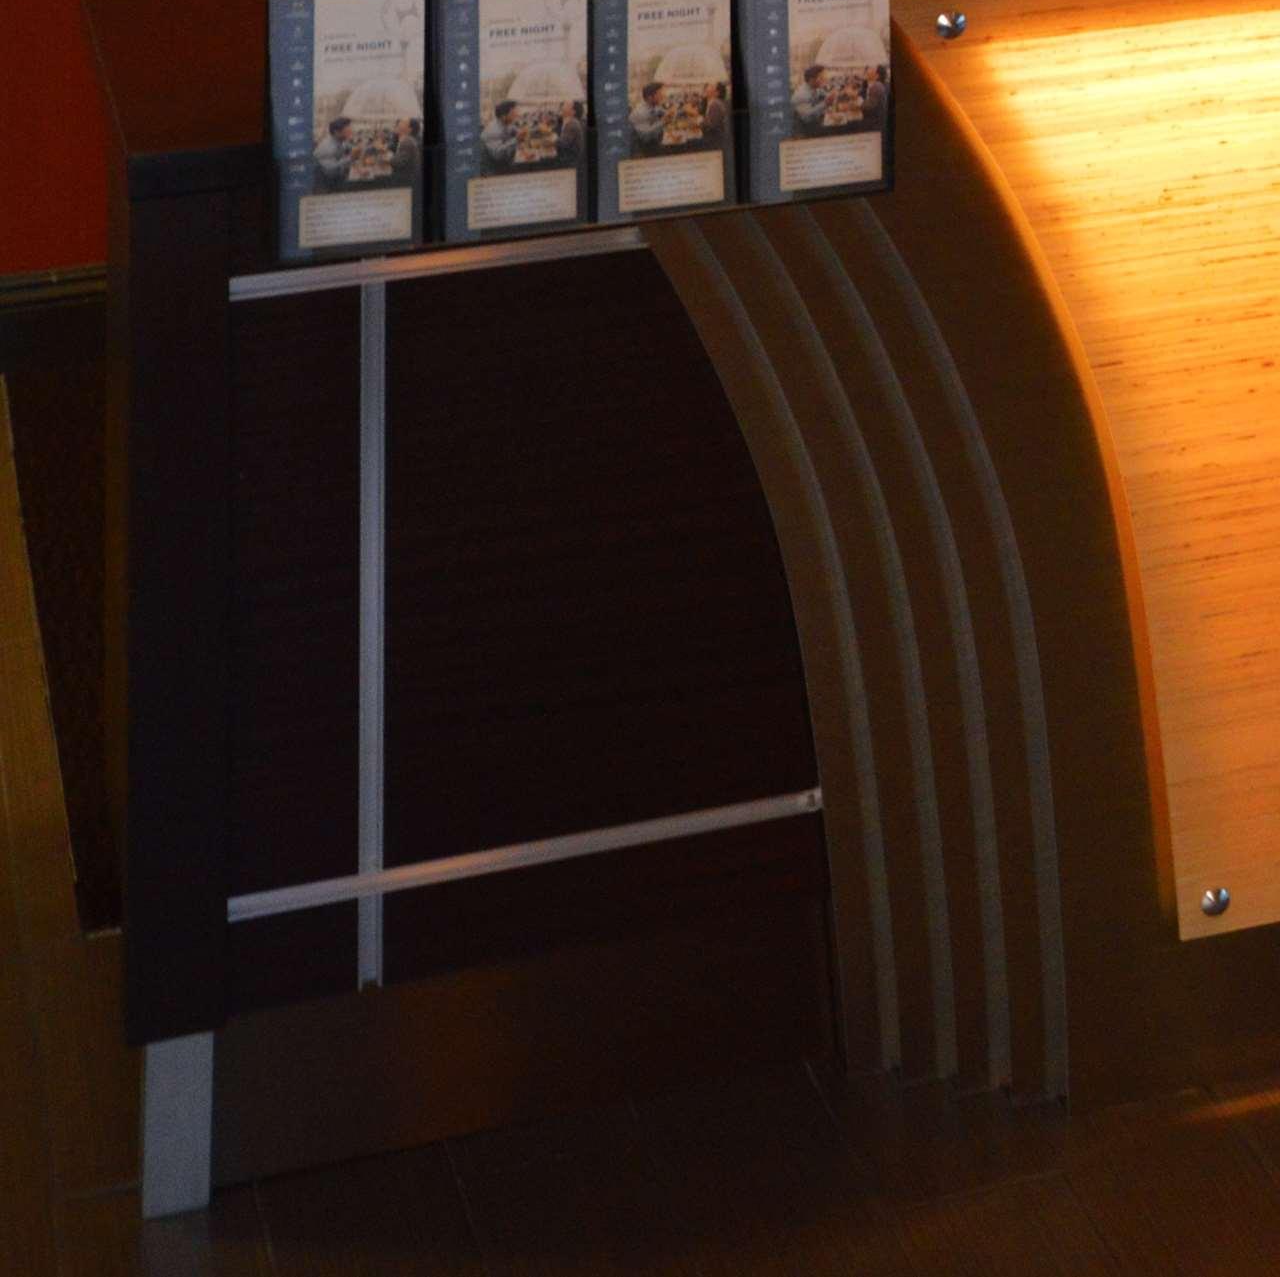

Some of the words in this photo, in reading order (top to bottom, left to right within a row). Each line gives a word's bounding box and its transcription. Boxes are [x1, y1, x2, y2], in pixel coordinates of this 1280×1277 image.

[638, 10, 665, 21] FREE
[667, 6, 703, 19] NIGHT
[489, 26, 518, 38] FREE
[521, 23, 556, 35] NIGHT
[324, 43, 353, 54] FREE
[356, 39, 392, 52] NIGHT
